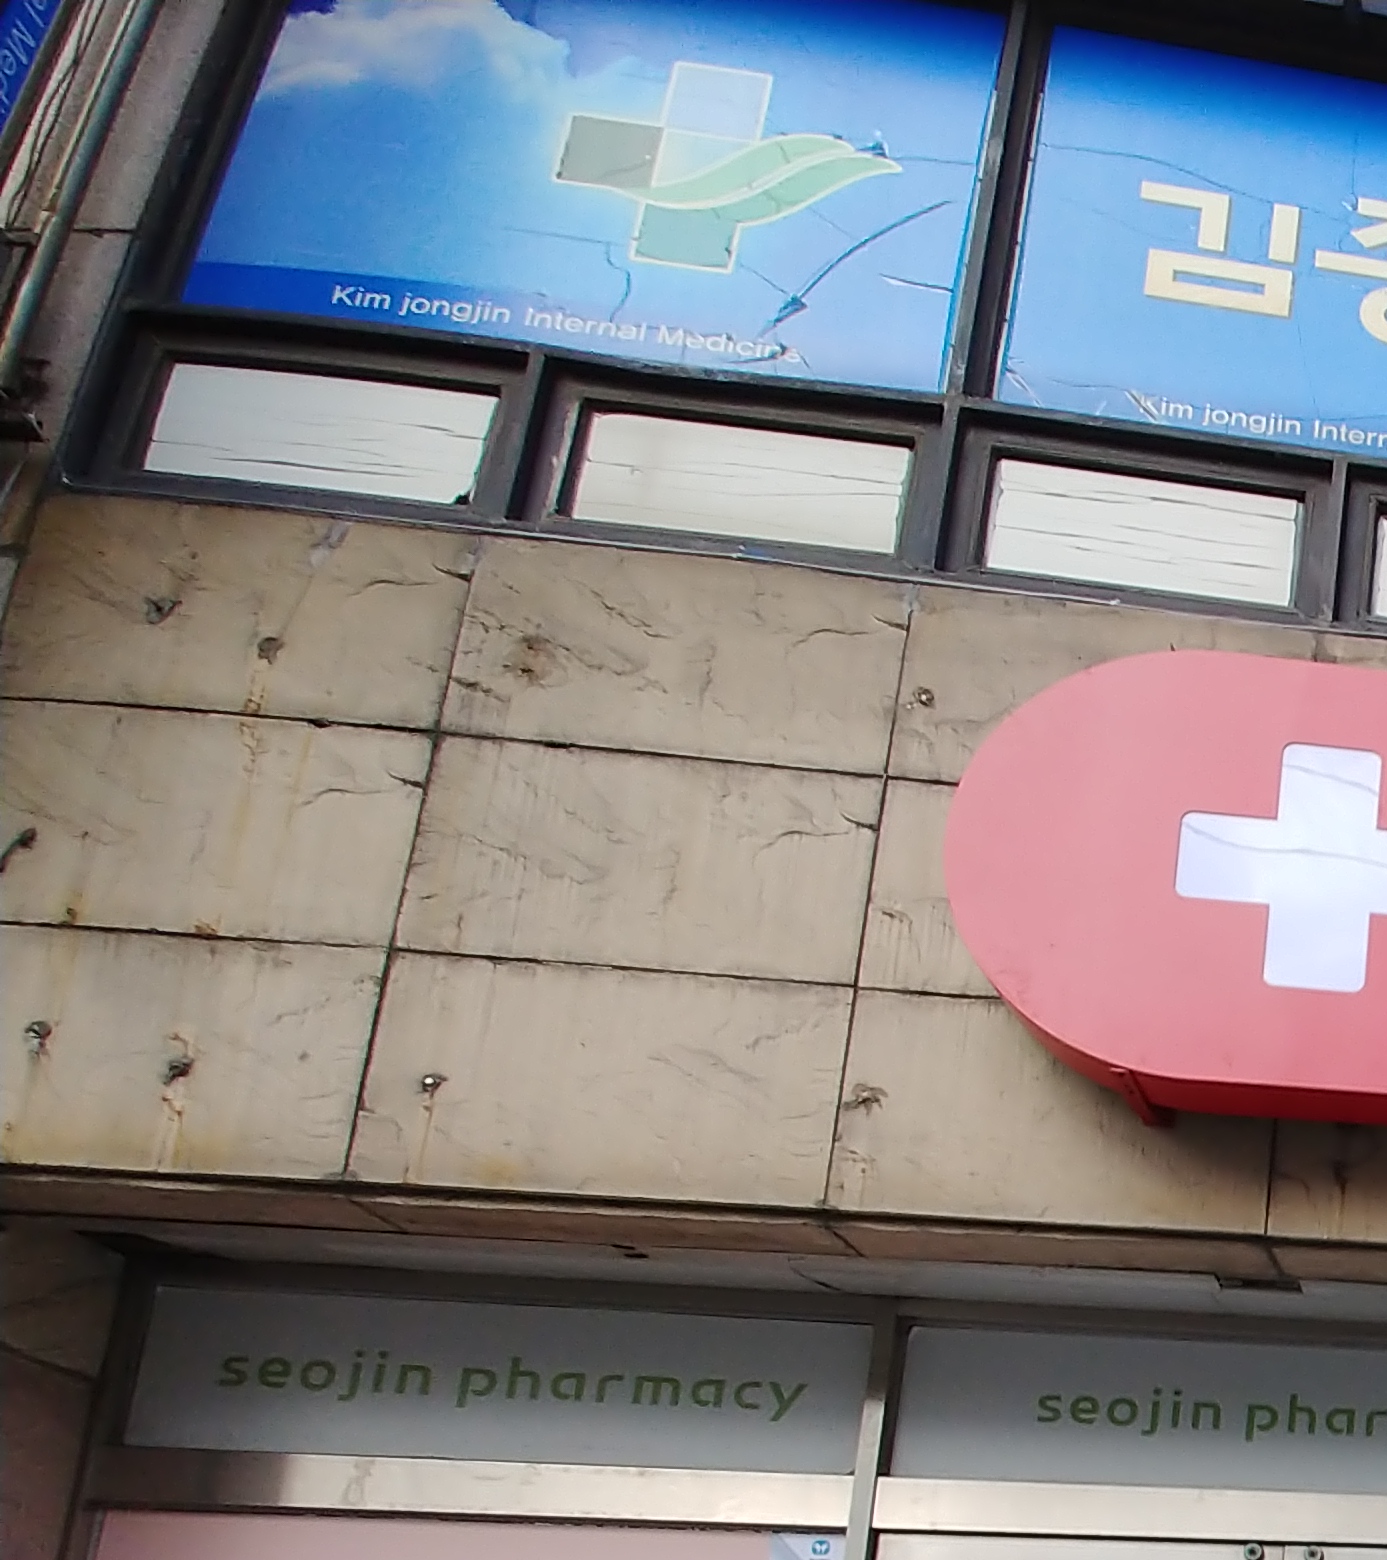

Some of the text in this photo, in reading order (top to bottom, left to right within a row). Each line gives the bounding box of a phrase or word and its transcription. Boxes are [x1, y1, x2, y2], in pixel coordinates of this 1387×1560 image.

[332, 284, 802, 363] Kim jongjin Internal Medicine
[1202, 401, 1301, 438] jongjin
[217, 1349, 808, 1422] seojin pharmacy
[1036, 1387, 1222, 1437] seojin
